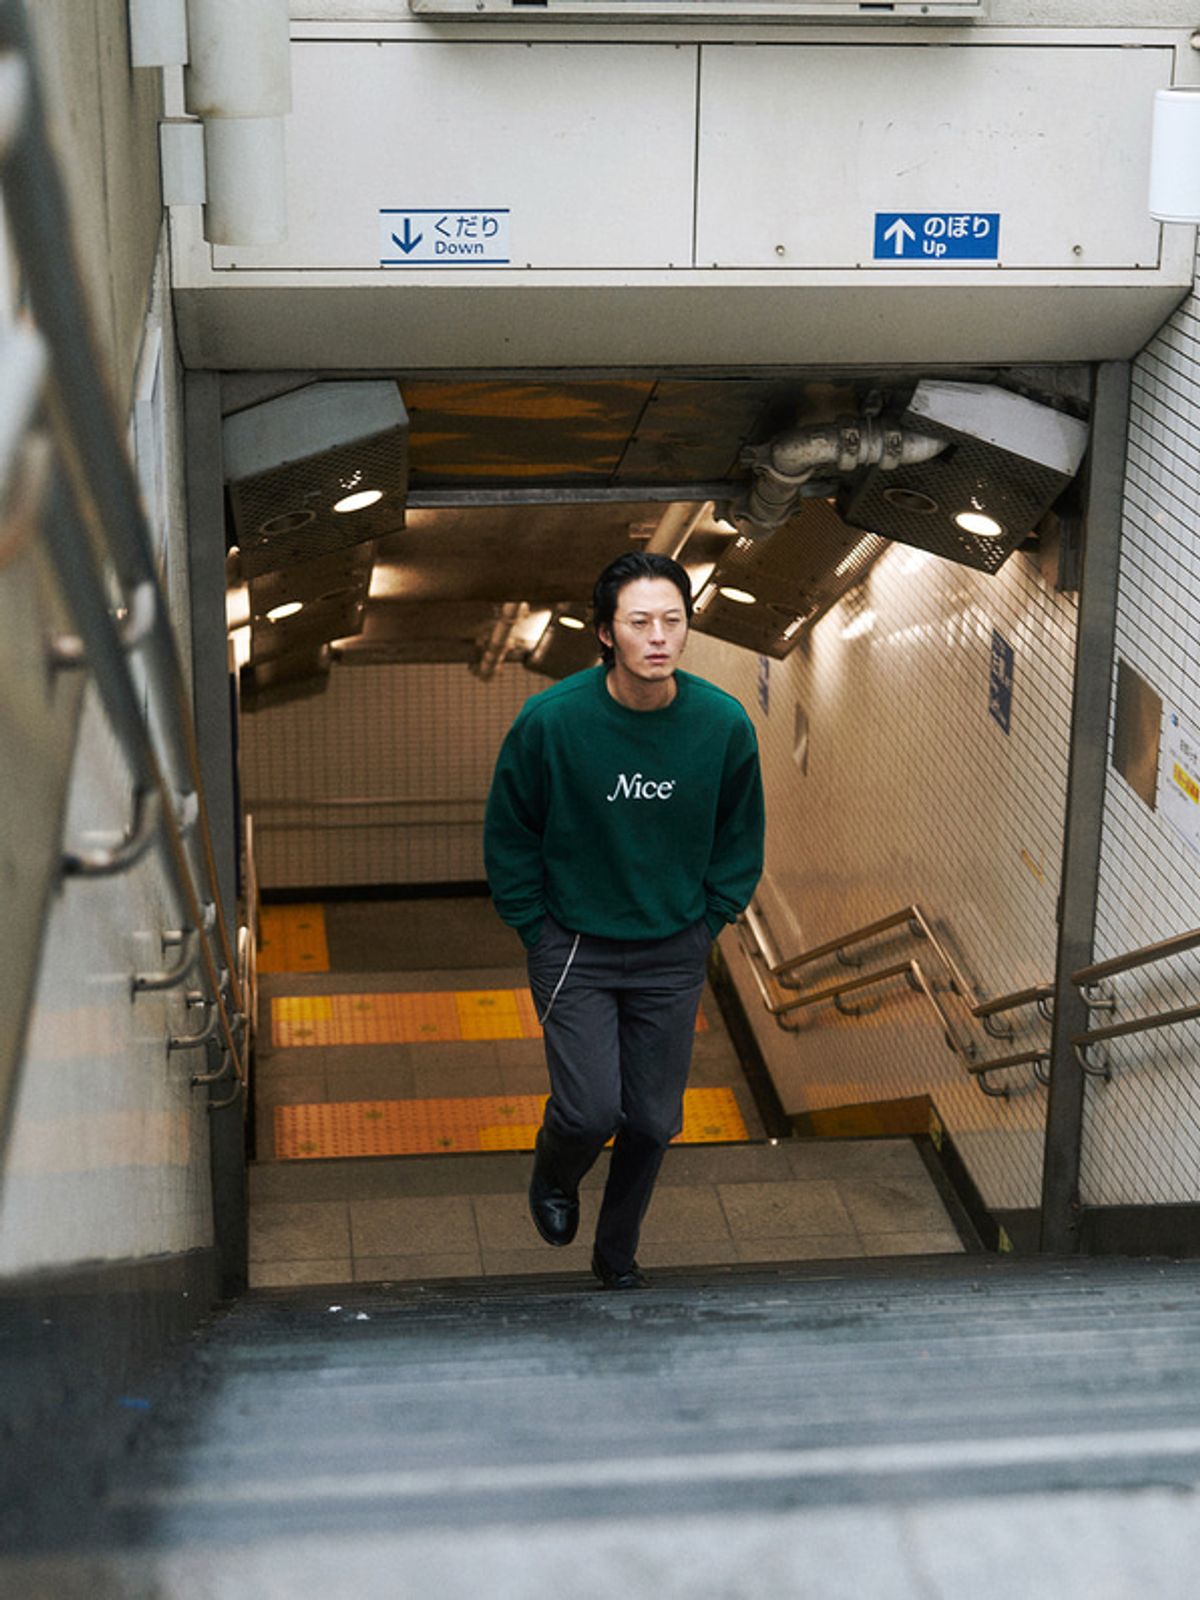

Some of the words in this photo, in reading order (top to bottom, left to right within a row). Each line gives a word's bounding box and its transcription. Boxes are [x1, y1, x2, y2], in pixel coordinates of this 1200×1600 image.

[434, 216, 499, 238] くだり
[923, 216, 991, 238] のぼり
[434, 241, 484, 255] Down
[922, 240, 947, 258] Up
[606, 773, 675, 802] Nice
